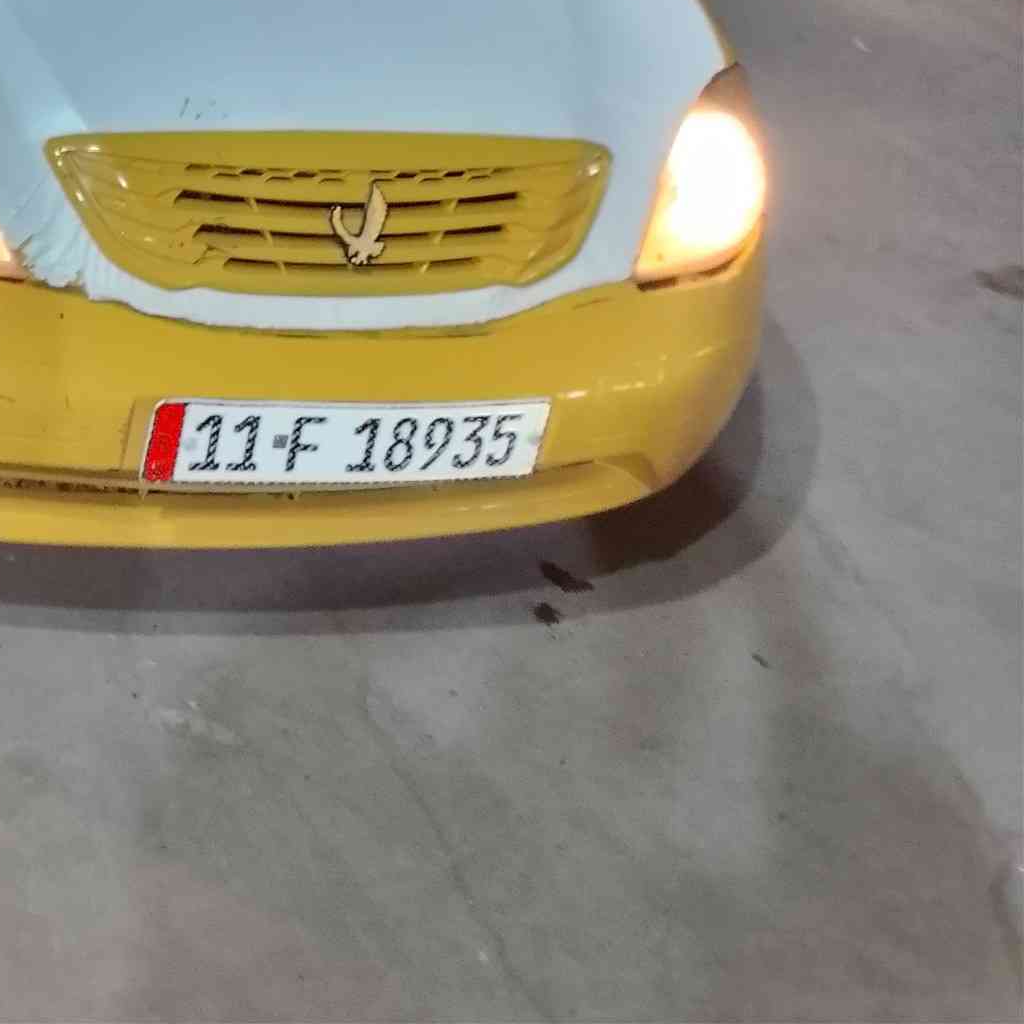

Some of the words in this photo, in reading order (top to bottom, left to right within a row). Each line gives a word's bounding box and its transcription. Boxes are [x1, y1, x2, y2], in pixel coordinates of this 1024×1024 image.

[188, 414, 261, 472] 11
[283, 415, 328, 472] F
[345, 414, 526, 473] 18935
